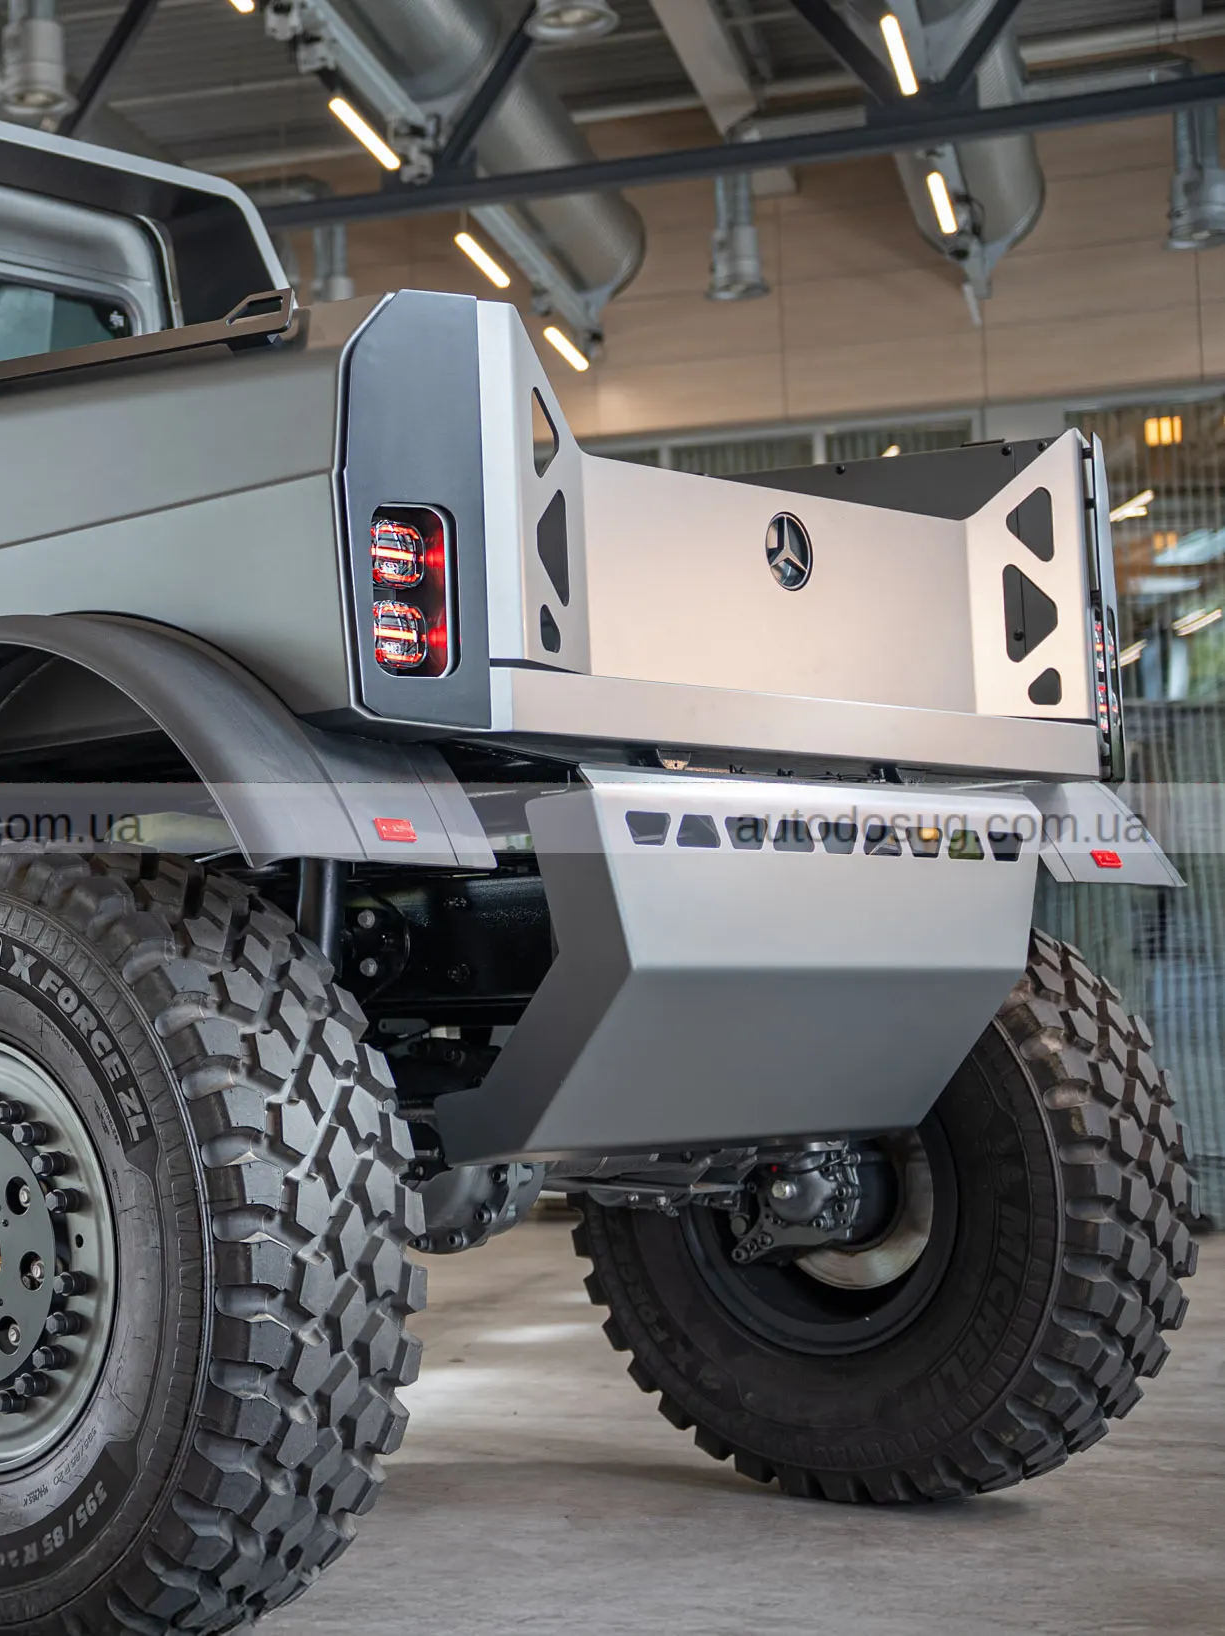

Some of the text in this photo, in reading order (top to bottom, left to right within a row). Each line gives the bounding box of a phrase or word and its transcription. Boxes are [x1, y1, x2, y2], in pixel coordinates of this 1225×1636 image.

[8, 945, 38, 986] X
[39, 968, 127, 1083] FORCE
[117, 1087, 148, 1142] ZL
[42, 1480, 108, 1556] 395/85
